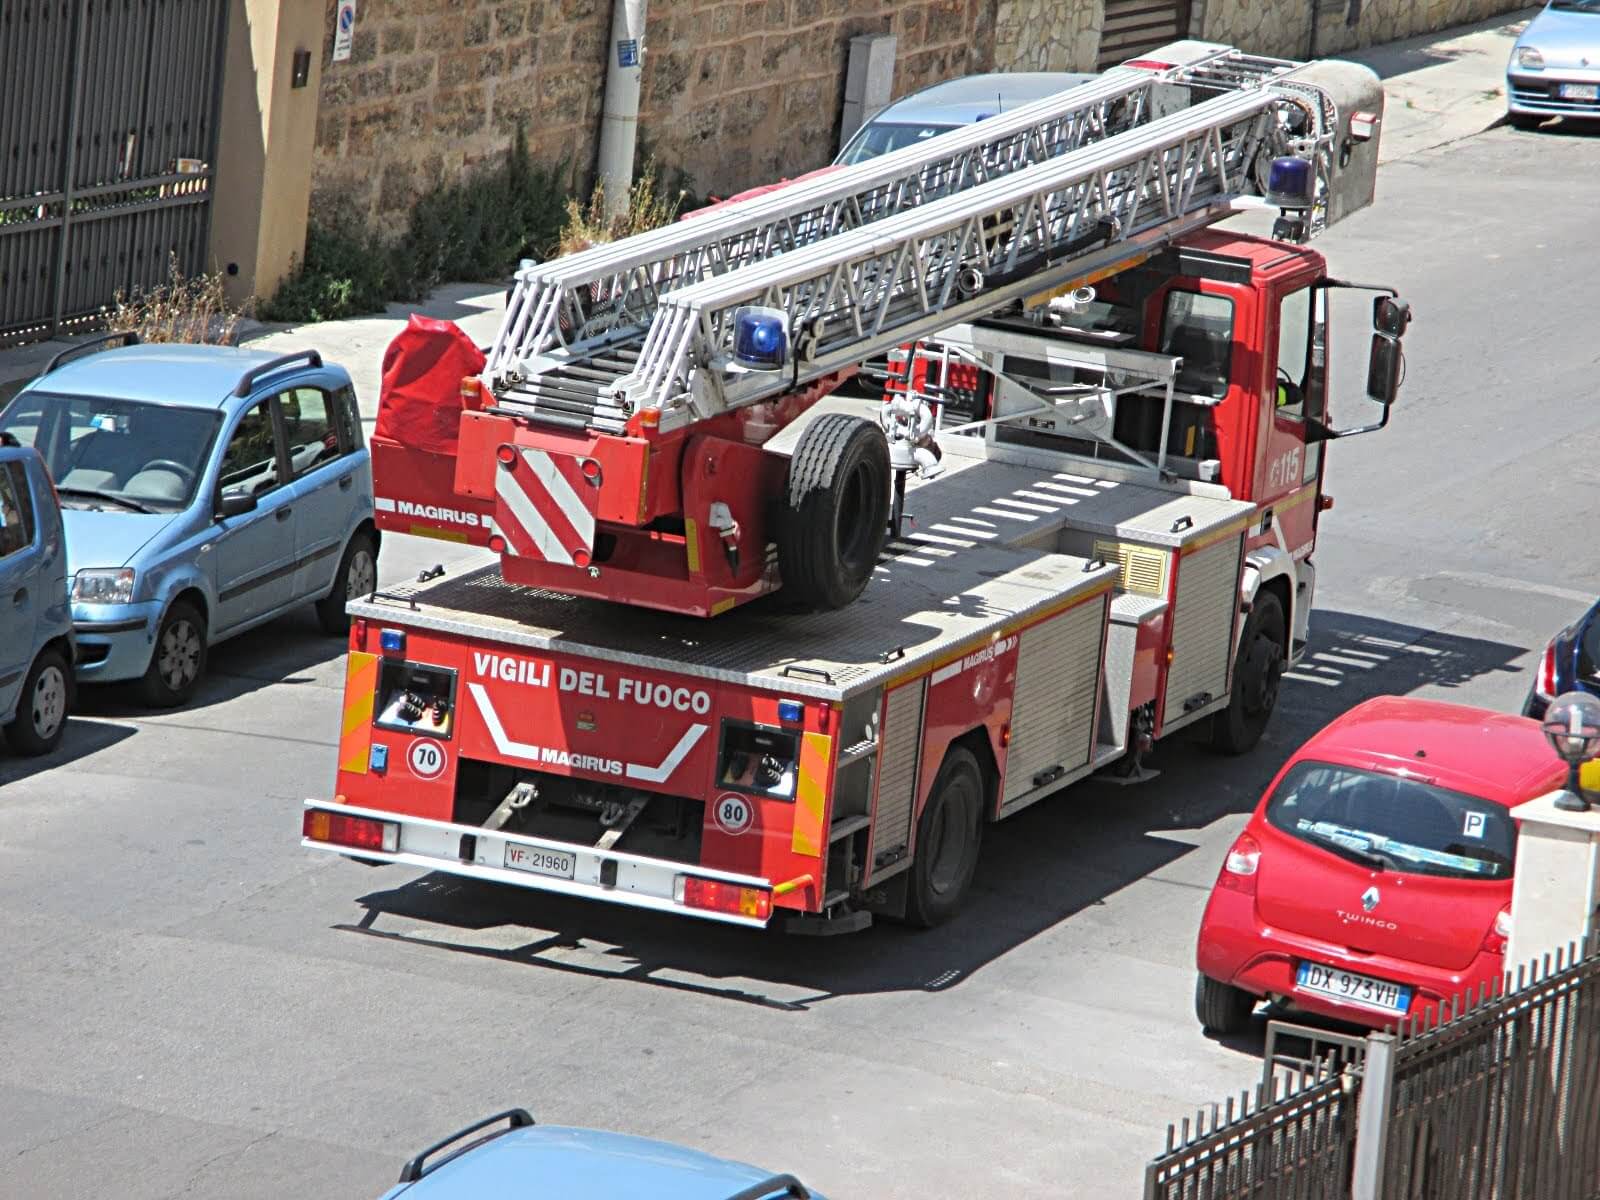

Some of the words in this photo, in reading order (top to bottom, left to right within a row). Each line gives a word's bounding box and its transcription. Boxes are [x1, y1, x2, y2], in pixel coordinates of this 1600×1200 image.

[1280, 447, 1300, 486] 115
[397, 500, 479, 526] MAGIRUS
[962, 646, 994, 671] MAGIRUS
[473, 652, 550, 688] VIGILI
[559, 668, 610, 699] DEL
[618, 677, 711, 715] FUOCO
[418, 748, 437, 766] 70
[541, 747, 623, 776] MAGIRUS
[724, 803, 743, 822] 80
[1467, 814, 1482, 833] P
[1335, 909, 1398, 931] TWINGO
[1310, 966, 1333, 989] DX
[1341, 974, 1398, 1006] 973VH
